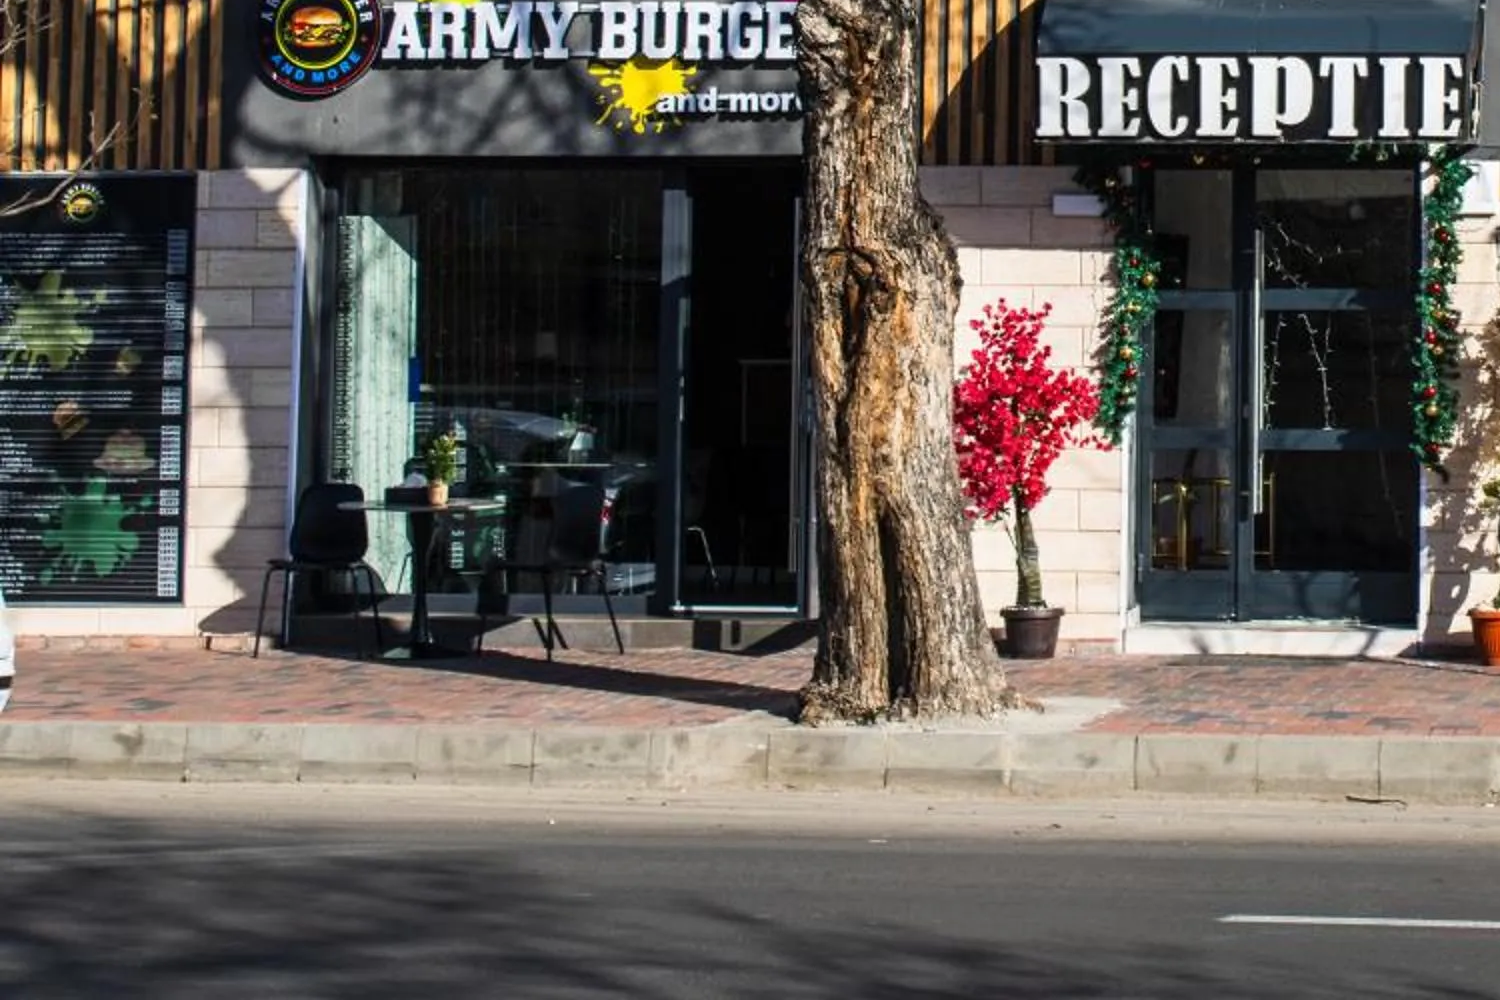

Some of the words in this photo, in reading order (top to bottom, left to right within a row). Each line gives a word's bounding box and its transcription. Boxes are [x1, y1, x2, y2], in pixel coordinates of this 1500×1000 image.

[381, 1, 579, 60] ARMY
[600, 1, 799, 60] BURGE
[271, 54, 306, 81] AND
[310, 50, 362, 83] MORE
[655, 86, 718, 113] and
[1035, 55, 1464, 138] RECEPTIE
